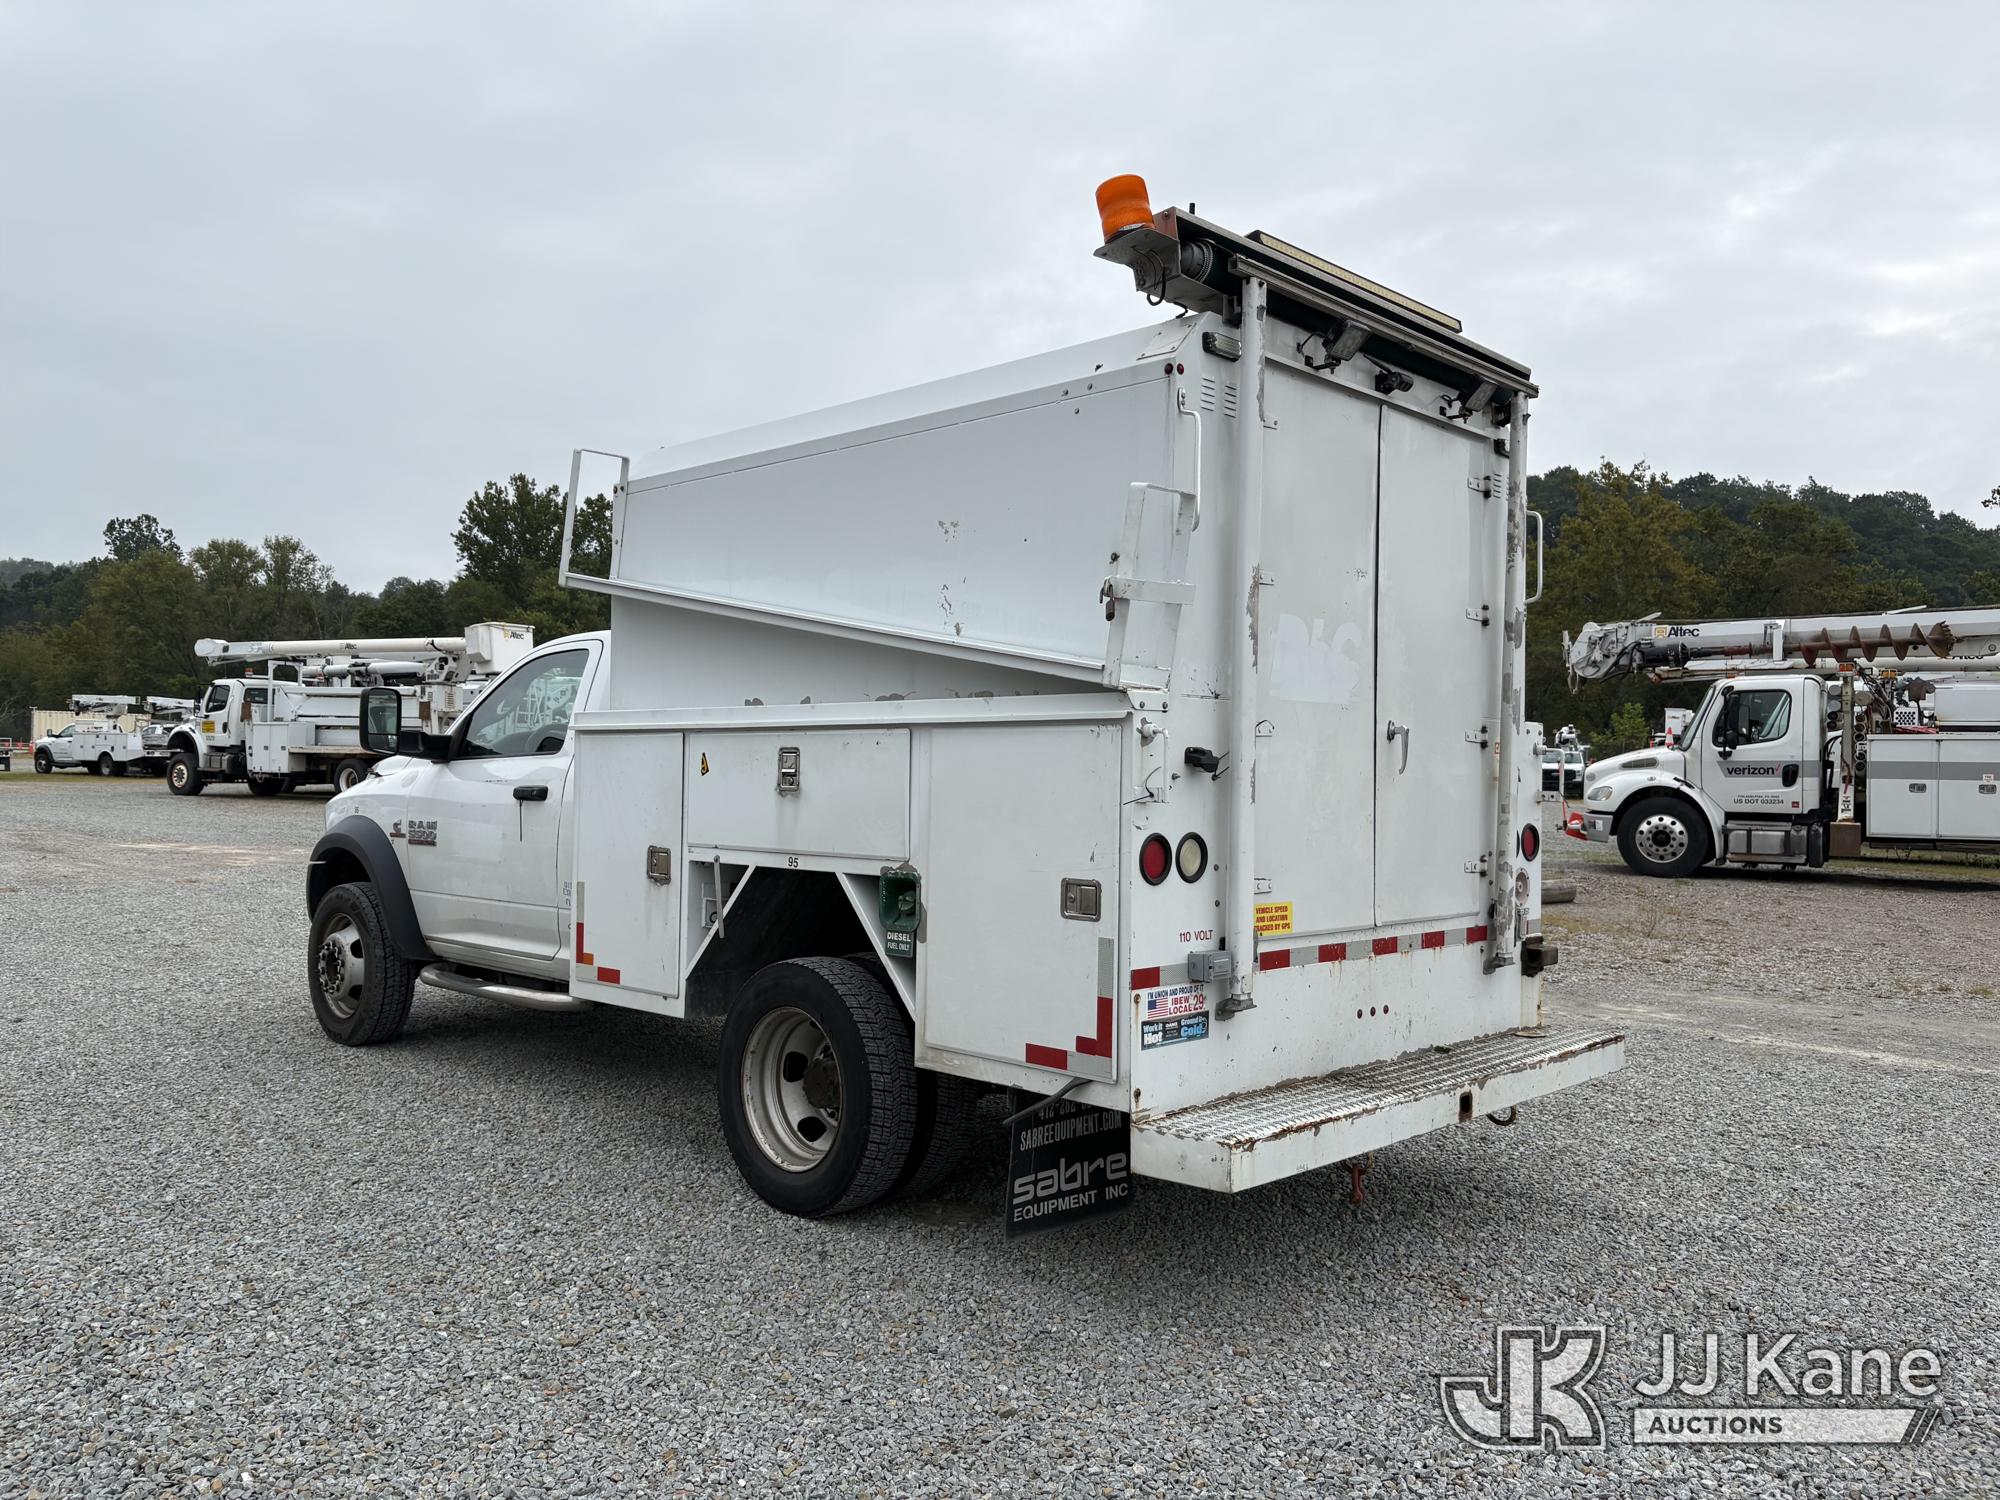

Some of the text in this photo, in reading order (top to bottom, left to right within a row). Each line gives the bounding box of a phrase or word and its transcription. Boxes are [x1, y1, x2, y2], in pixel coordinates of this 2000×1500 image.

[1668, 626, 1700, 638] Altec
[1726, 764, 1775, 776] verizon
[408, 820, 438, 830] RAM
[788, 856, 799, 868] 95
[1266, 914, 1288, 922] LOCATION
[1282, 922, 1290, 930] GPS
[887, 931, 912, 942] DIESEL
[1179, 929, 1214, 943] 110 VOLT
[887, 941, 910, 951] FUEL ONLY
[1155, 991, 1168, 999] UNION
[1169, 988, 1179, 996] AND
[1179, 985, 1193, 995] PROUD
[1171, 996, 1190, 1006] IBEW
[1193, 994, 1204, 1011] 29
[1168, 1006, 1193, 1015] LOCAL
[1181, 1017, 1199, 1025] Ground
[1143, 1025, 1158, 1033] Work
[1020, 1110, 1122, 1152] SABREEQUIPMENT.COM
[1012, 1152, 1128, 1205] sabre
[1013, 1183, 1129, 1222] EQUIPMENT INC
